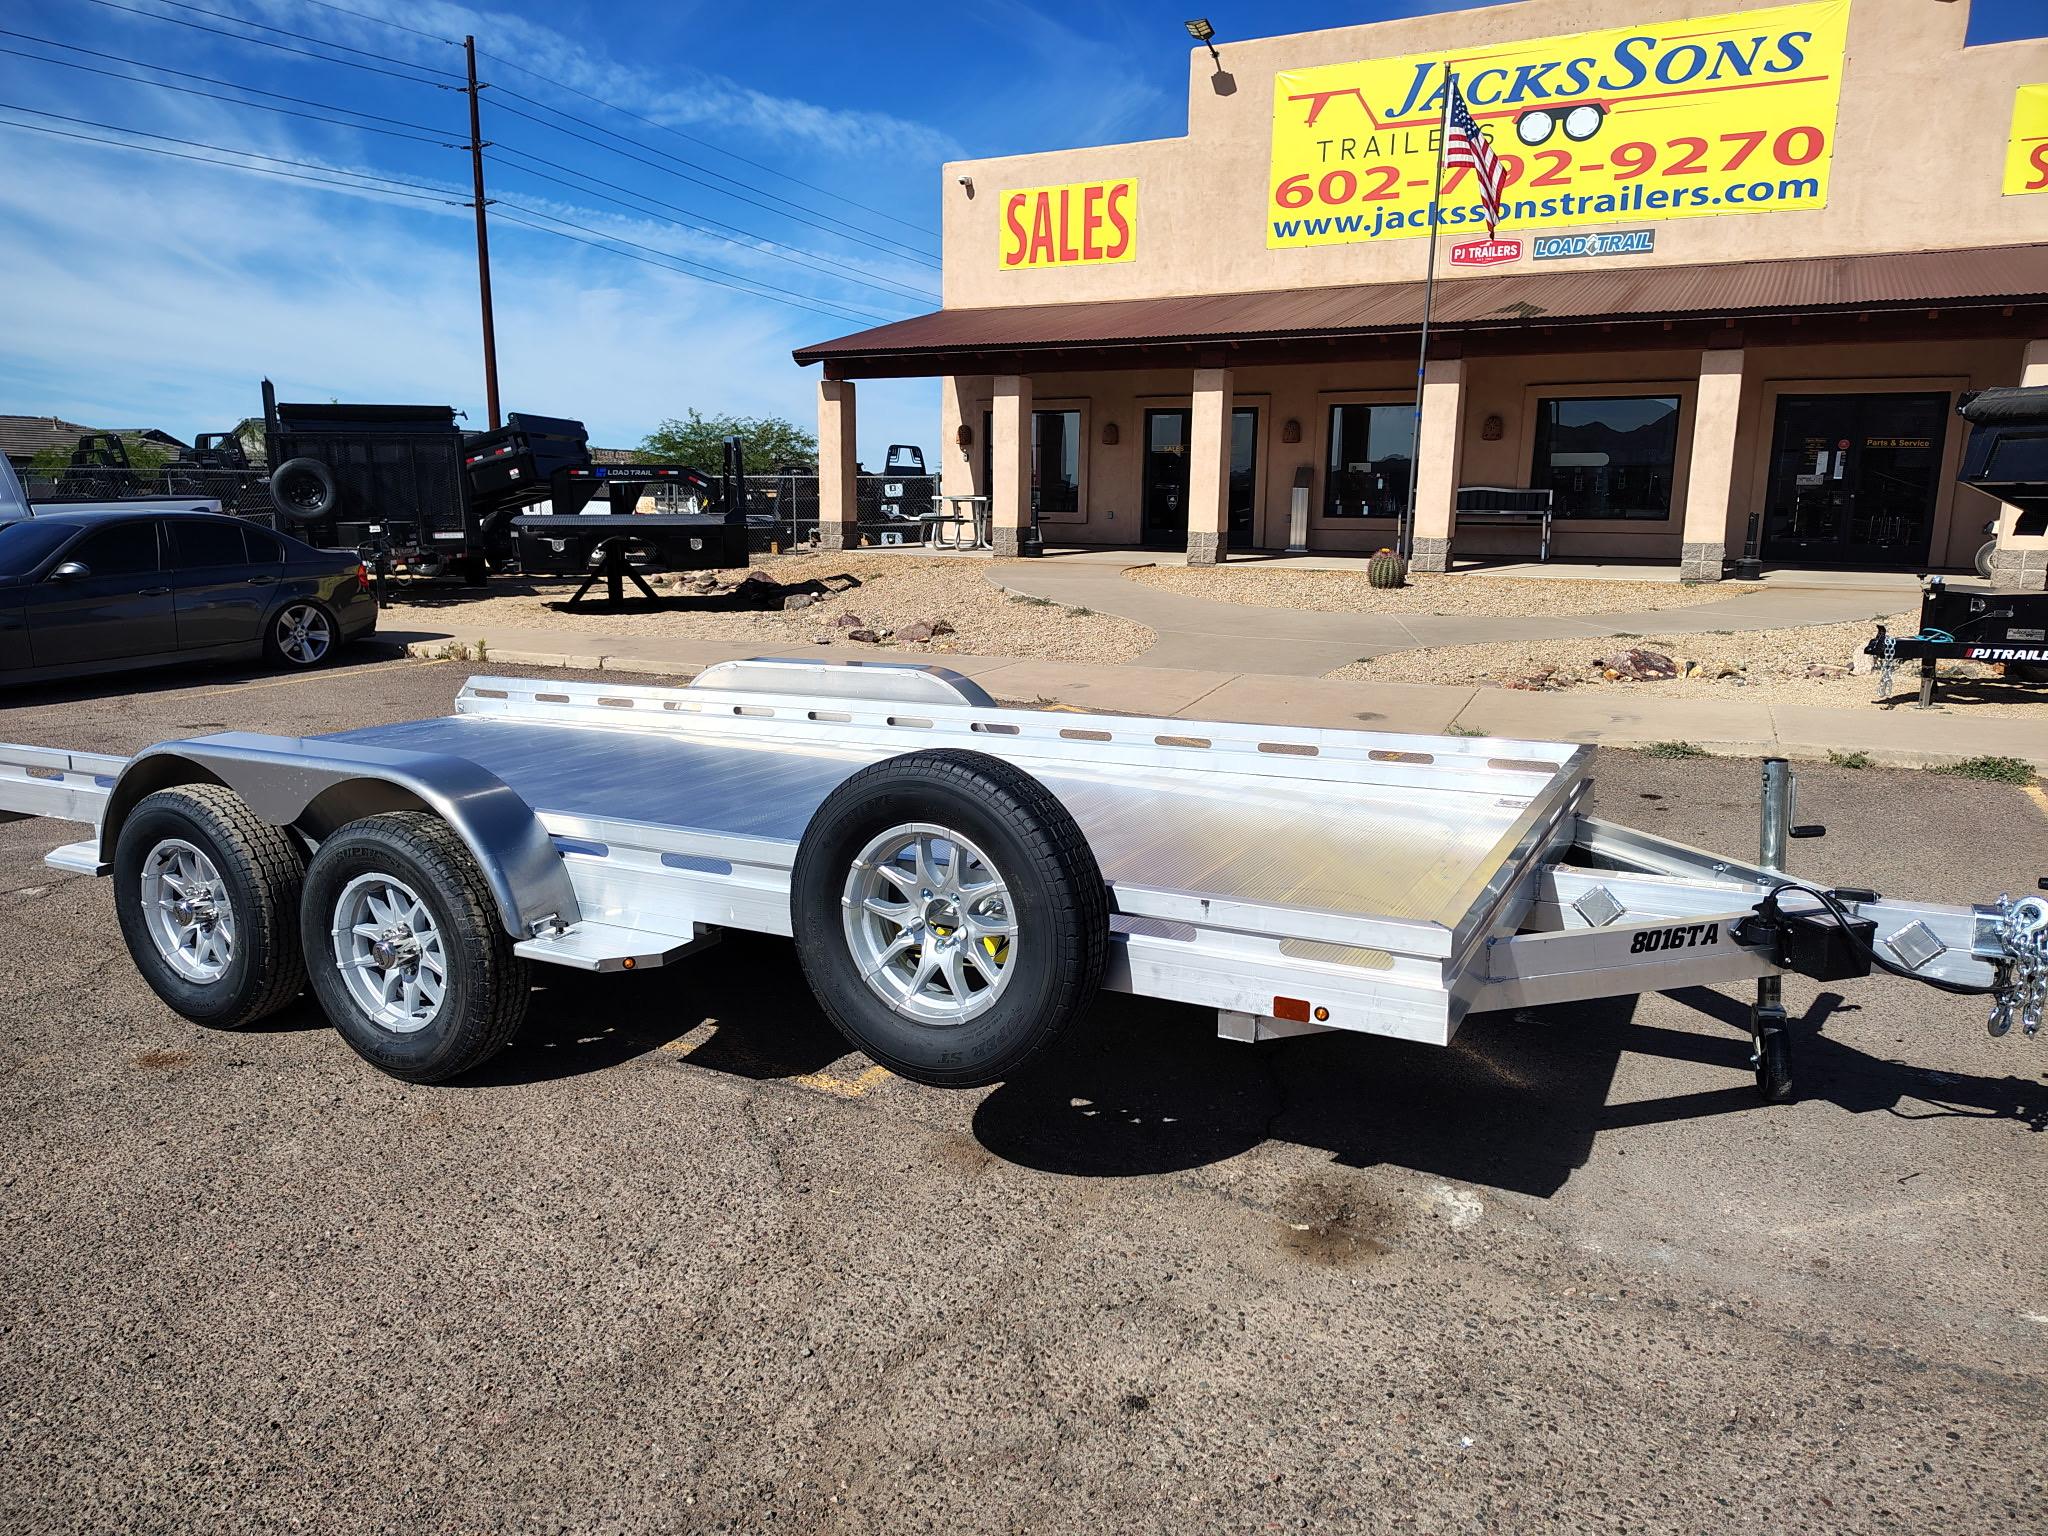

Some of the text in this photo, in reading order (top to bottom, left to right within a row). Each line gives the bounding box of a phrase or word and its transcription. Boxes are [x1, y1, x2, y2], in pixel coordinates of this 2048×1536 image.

[1317, 123, 1494, 162] TRAILES
[1273, 177, 1819, 238] www.jackssonstrailers.com
[1006, 184, 1129, 265] SALES
[1454, 245, 1518, 259] PJ TRAILERS
[1534, 232, 1652, 257] LOAD TRAIL
[1867, 439, 1930, 447] Parts & Service
[1971, 648, 1991, 659] PJ
[1630, 923, 1719, 954] 8016TA
